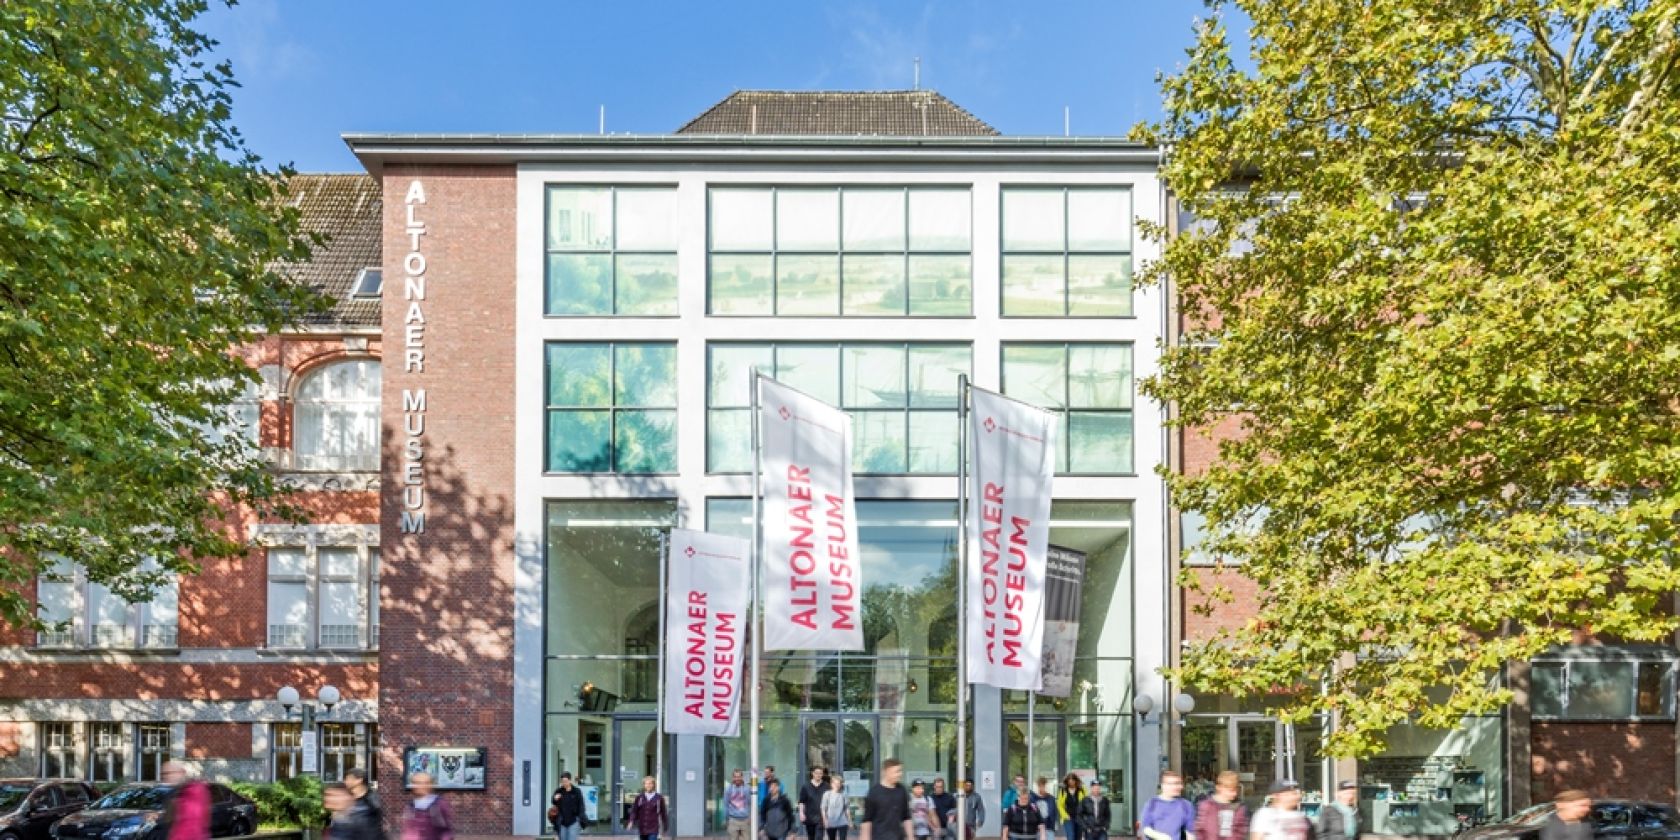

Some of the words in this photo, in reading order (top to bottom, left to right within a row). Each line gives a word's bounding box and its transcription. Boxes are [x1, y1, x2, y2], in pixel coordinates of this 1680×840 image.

[404, 180, 426, 372] ALTONAER
[402, 389, 426, 534] MUSEUM
[788, 465, 818, 630] ALTONAER
[826, 494, 855, 630] MUSEUM
[1002, 516, 1030, 668] MUSEUM
[685, 590, 708, 718] ALTONAER
[712, 612, 736, 720] MUSEUM
